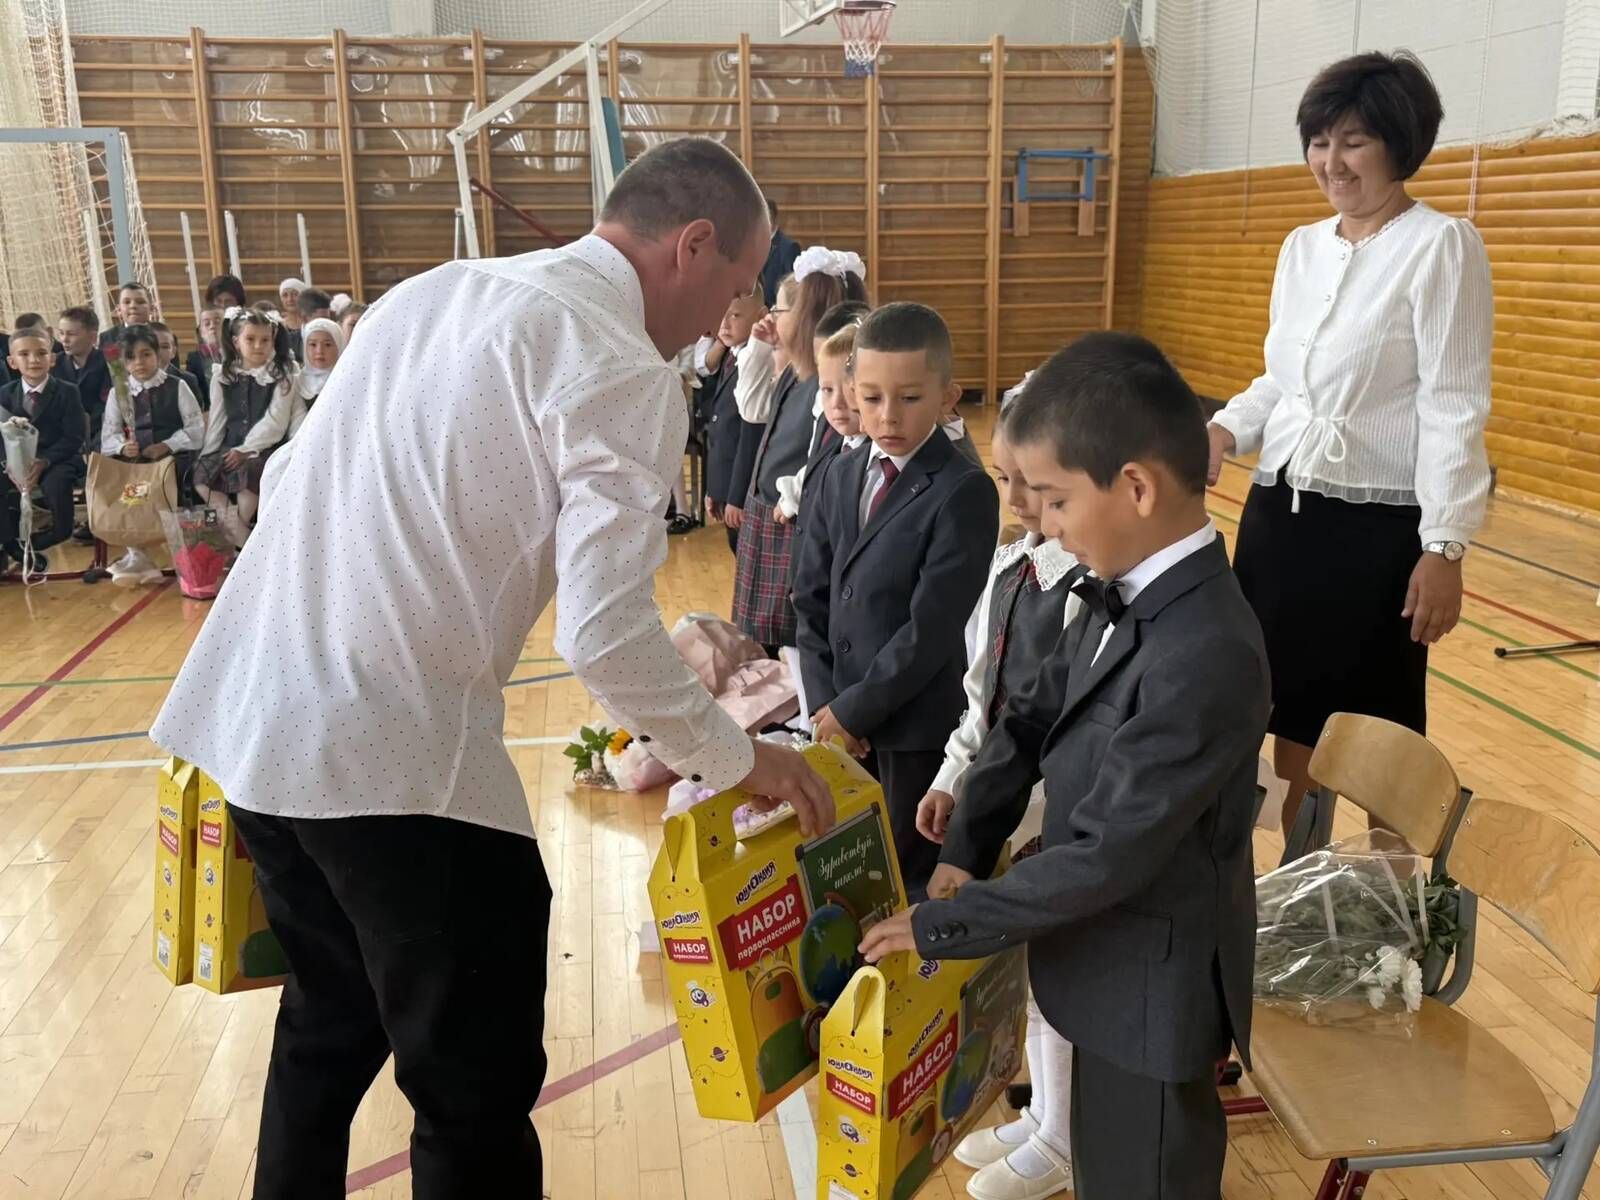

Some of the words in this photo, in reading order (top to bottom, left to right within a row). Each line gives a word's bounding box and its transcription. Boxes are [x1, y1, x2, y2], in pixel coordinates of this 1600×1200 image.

[818, 834, 875, 880] Здравствуй,
[834, 859, 865, 889] школа!
[737, 893, 796, 944] НАБОР
[738, 916, 800, 960] первоклассника
[673, 943, 706, 953] НАБОР
[903, 1032, 953, 1095] НАБОР
[835, 1080, 871, 1104] НАБОР
